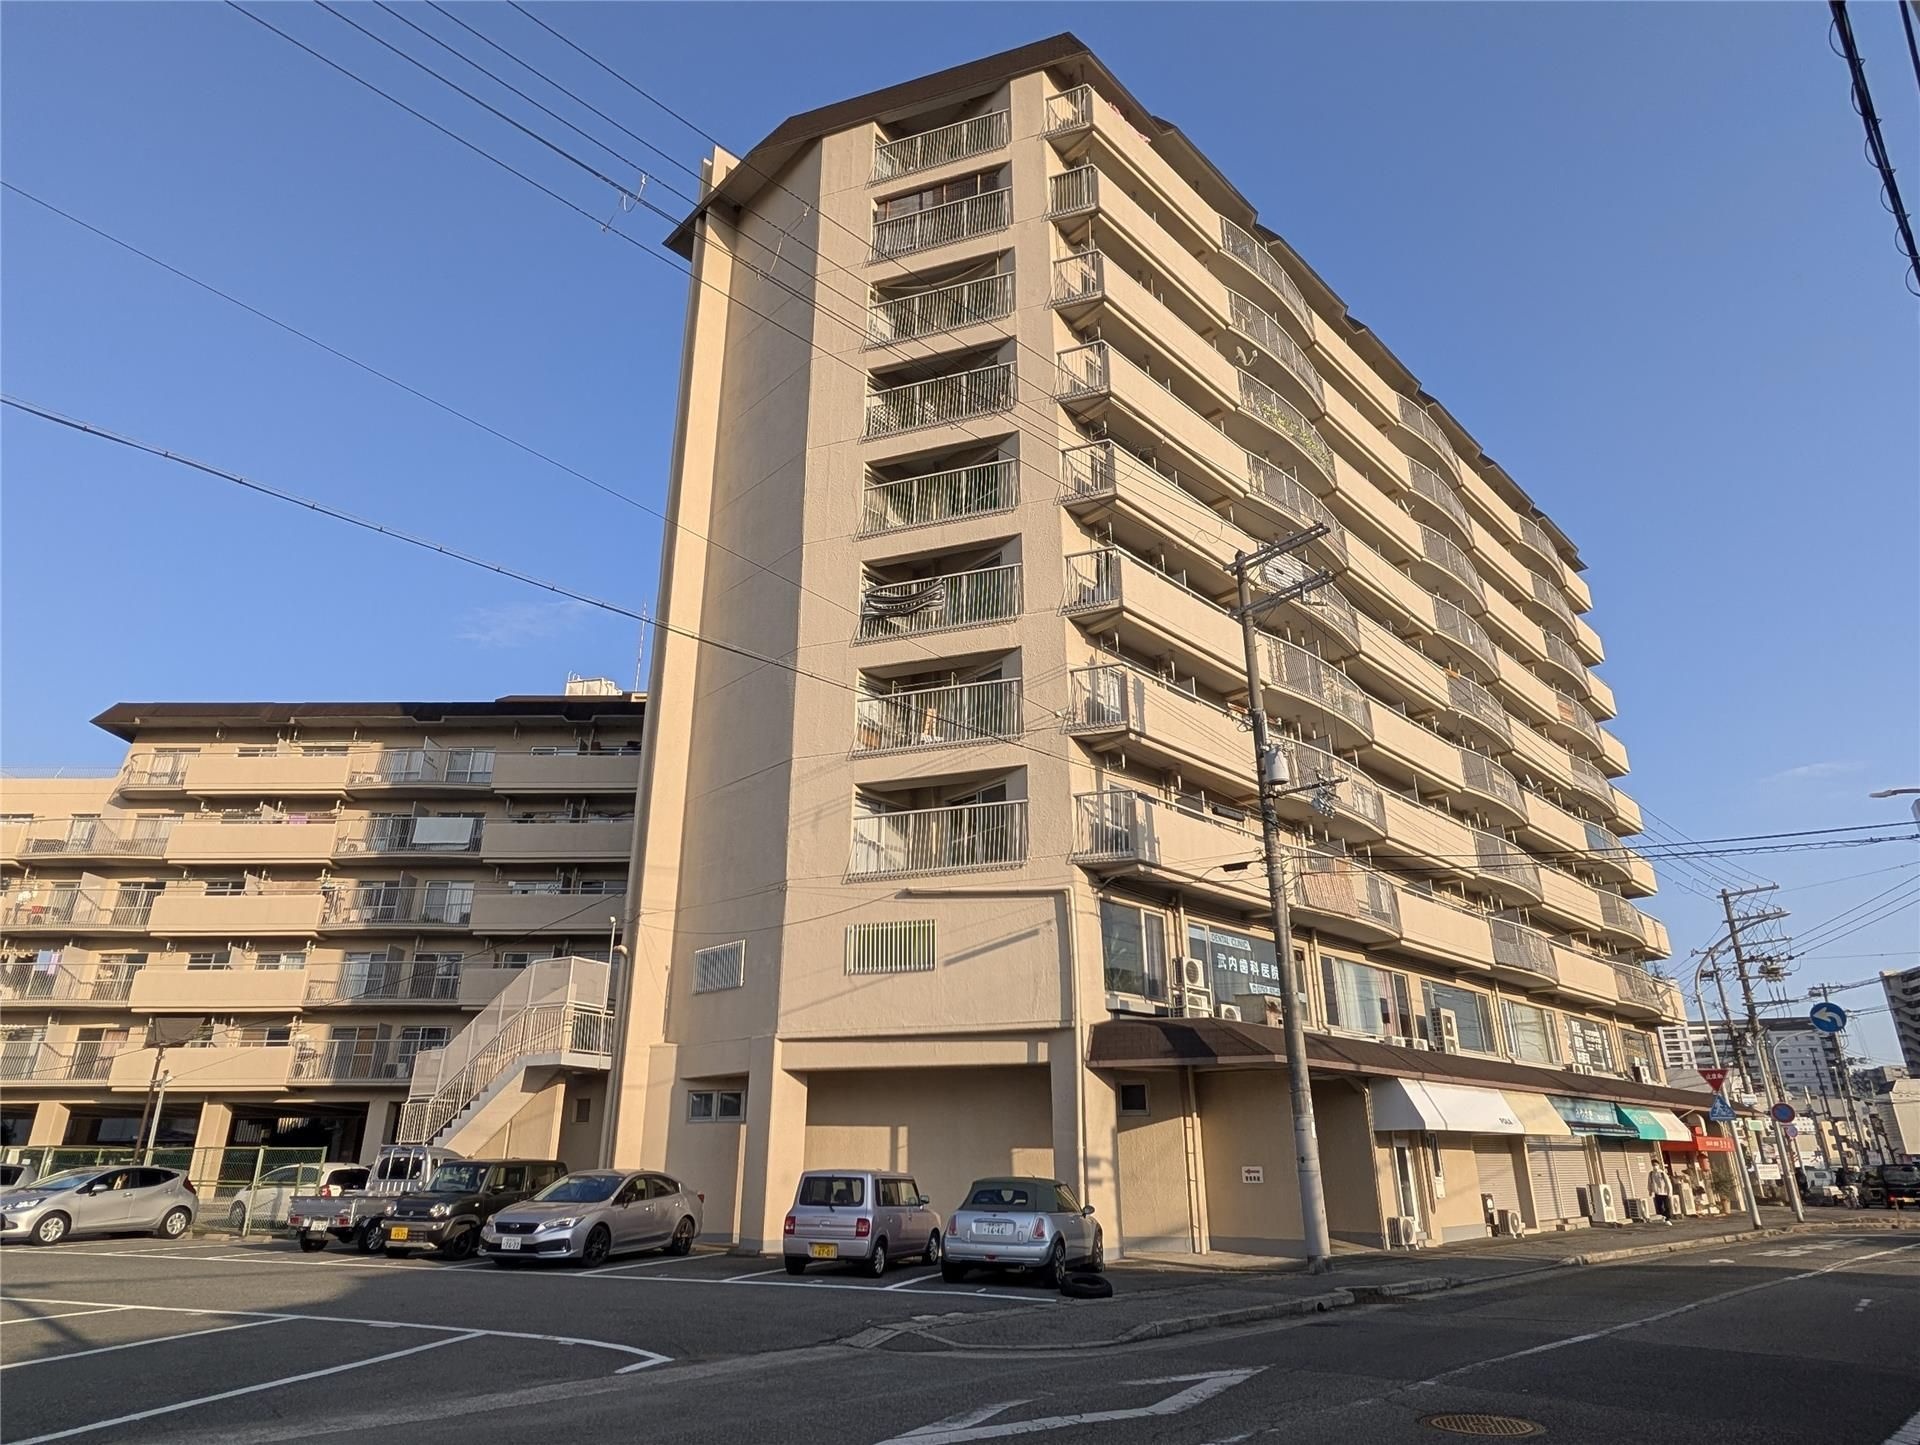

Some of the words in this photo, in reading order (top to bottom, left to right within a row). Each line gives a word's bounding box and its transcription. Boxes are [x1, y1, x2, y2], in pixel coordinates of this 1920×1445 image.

[1211, 932, 1229, 945] DENTAL
[1231, 936, 1248, 949] CLINIC
[1217, 953, 1279, 981] 武内歯科医院
